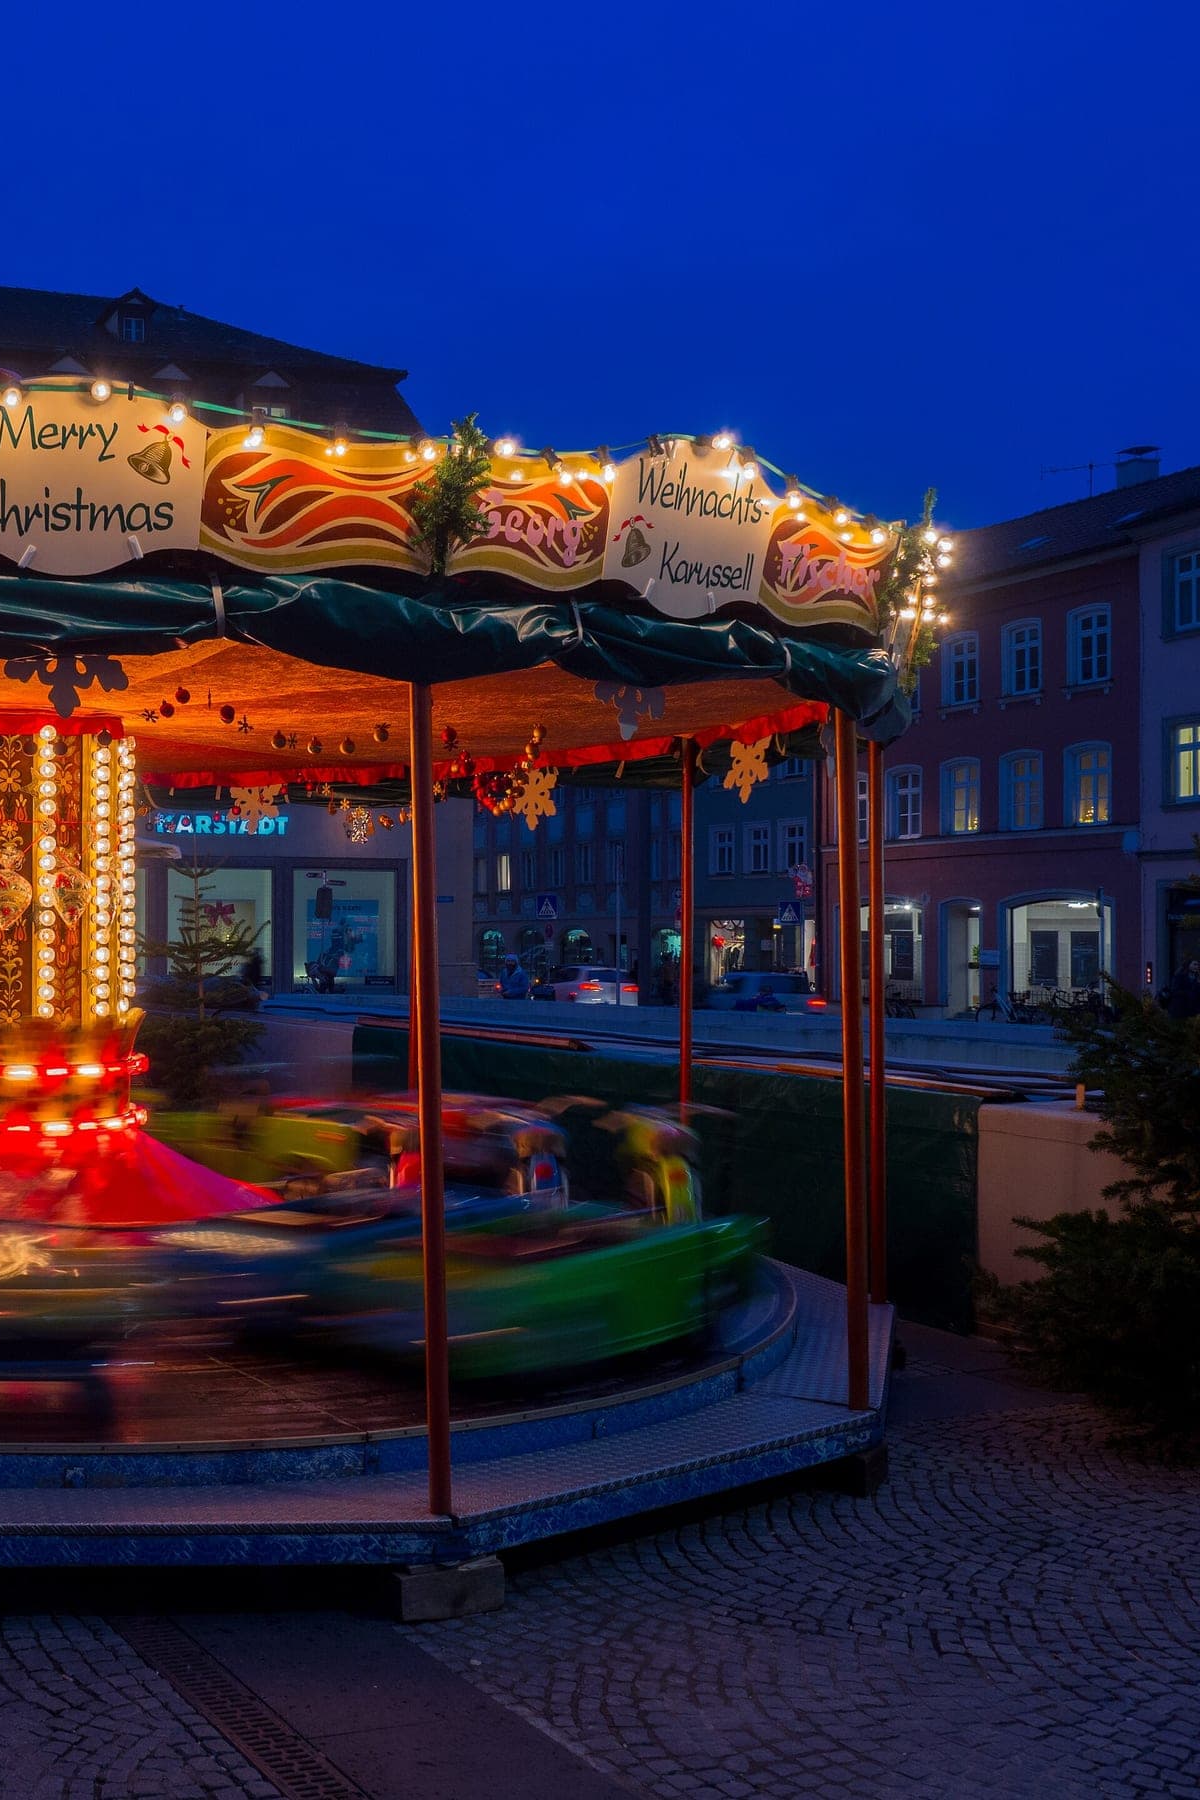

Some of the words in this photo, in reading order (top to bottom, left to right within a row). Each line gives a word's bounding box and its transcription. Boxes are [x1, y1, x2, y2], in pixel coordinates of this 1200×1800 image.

[638, 457, 770, 526] Weihnachts-
[659, 541, 755, 591] Karussell
[779, 541, 881, 597] Fischer
